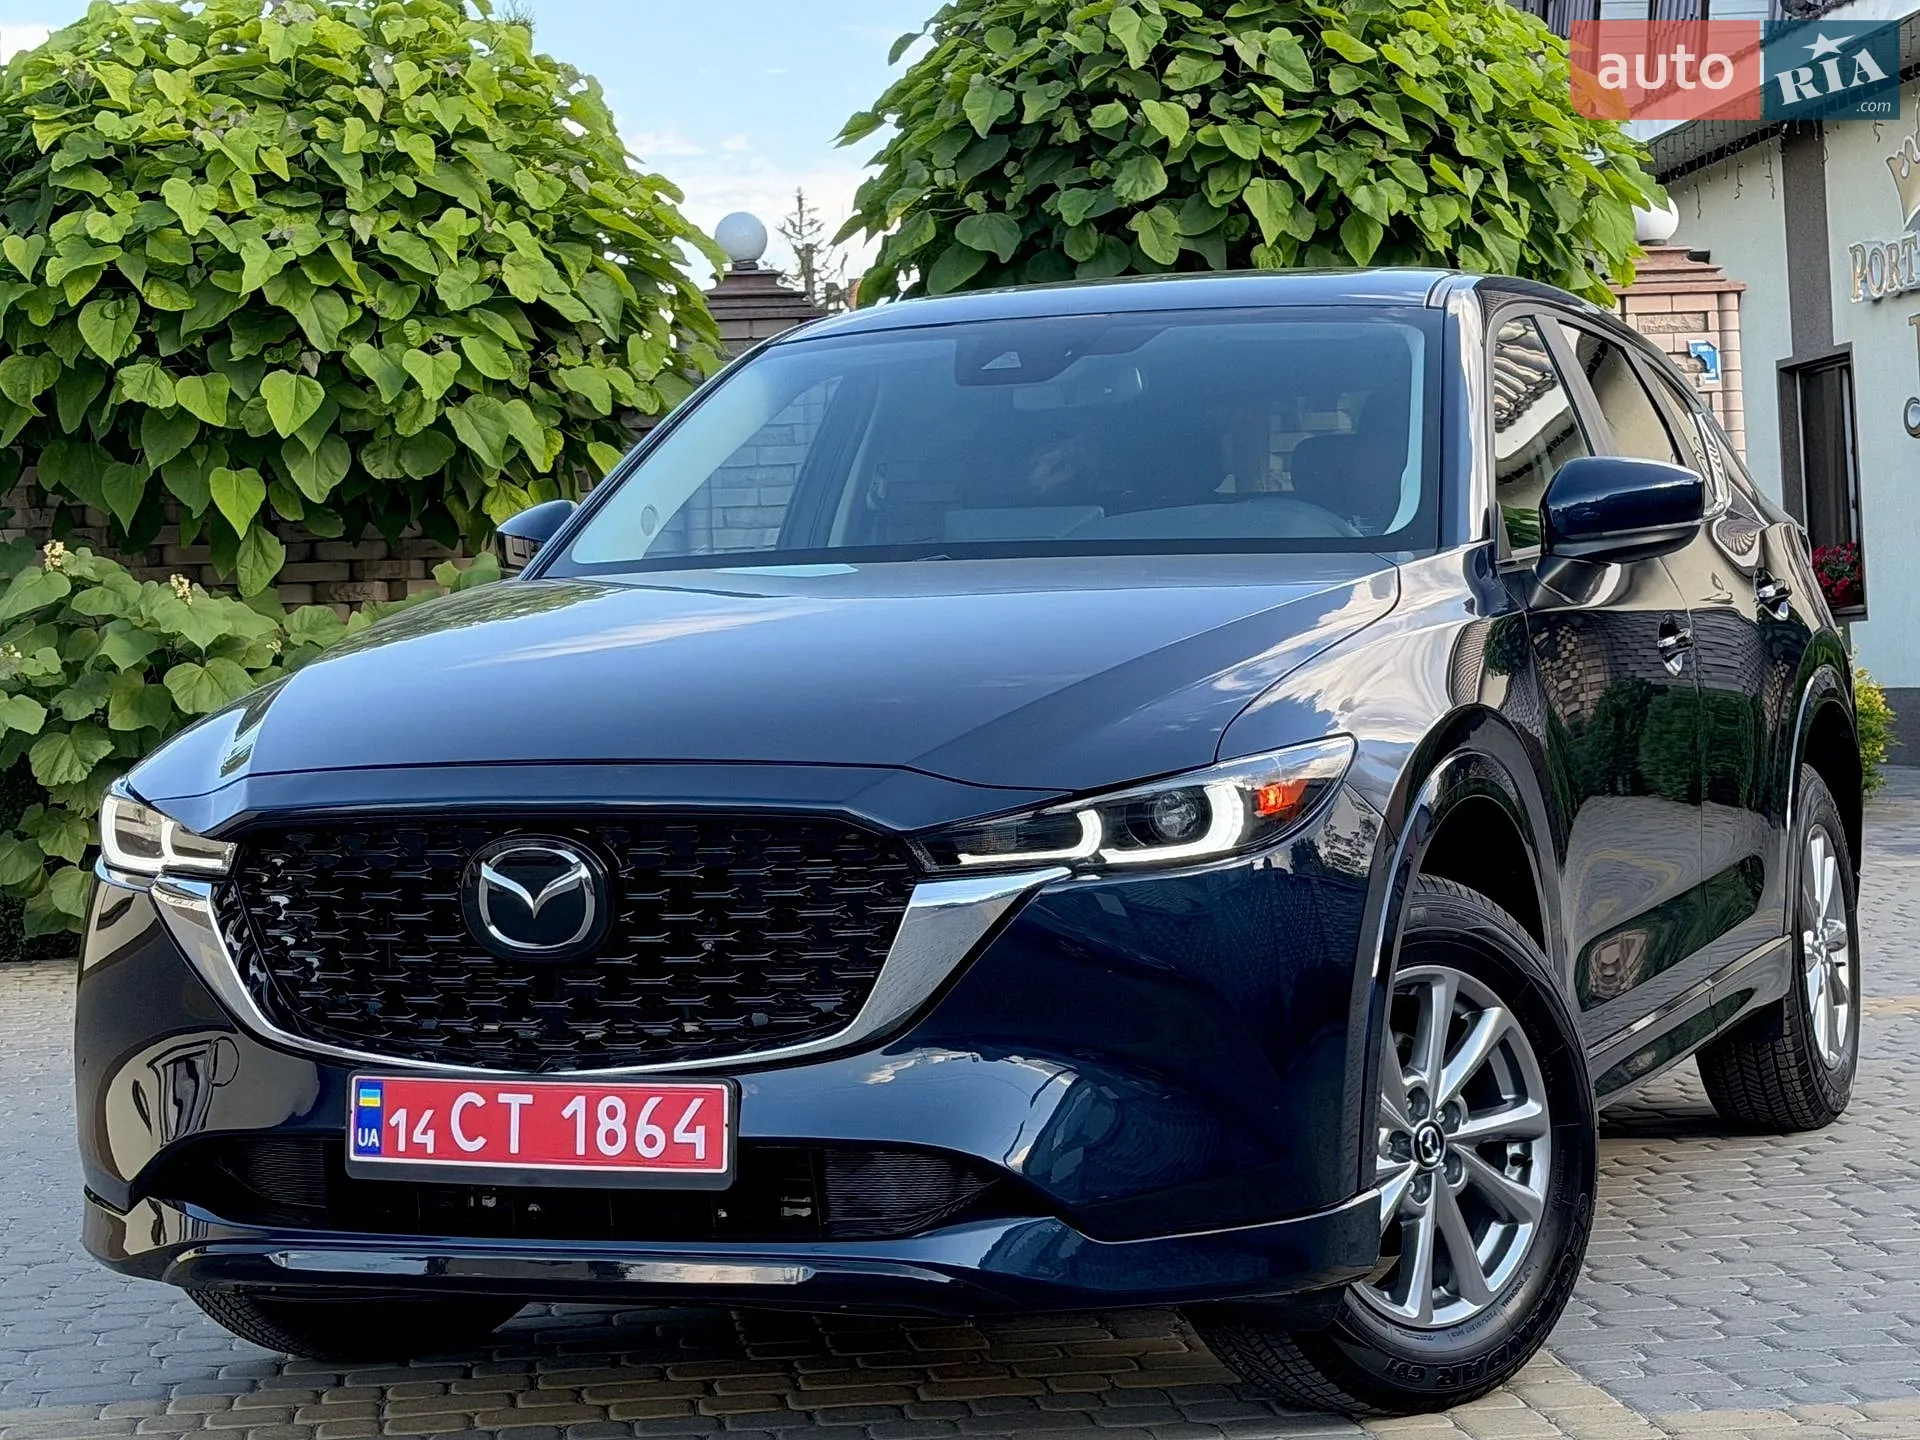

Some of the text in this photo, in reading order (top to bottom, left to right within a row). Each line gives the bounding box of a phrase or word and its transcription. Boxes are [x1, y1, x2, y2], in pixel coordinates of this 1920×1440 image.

[357, 1127, 380, 1148] UA
[389, 1091, 706, 1160] 14 CT 1864
